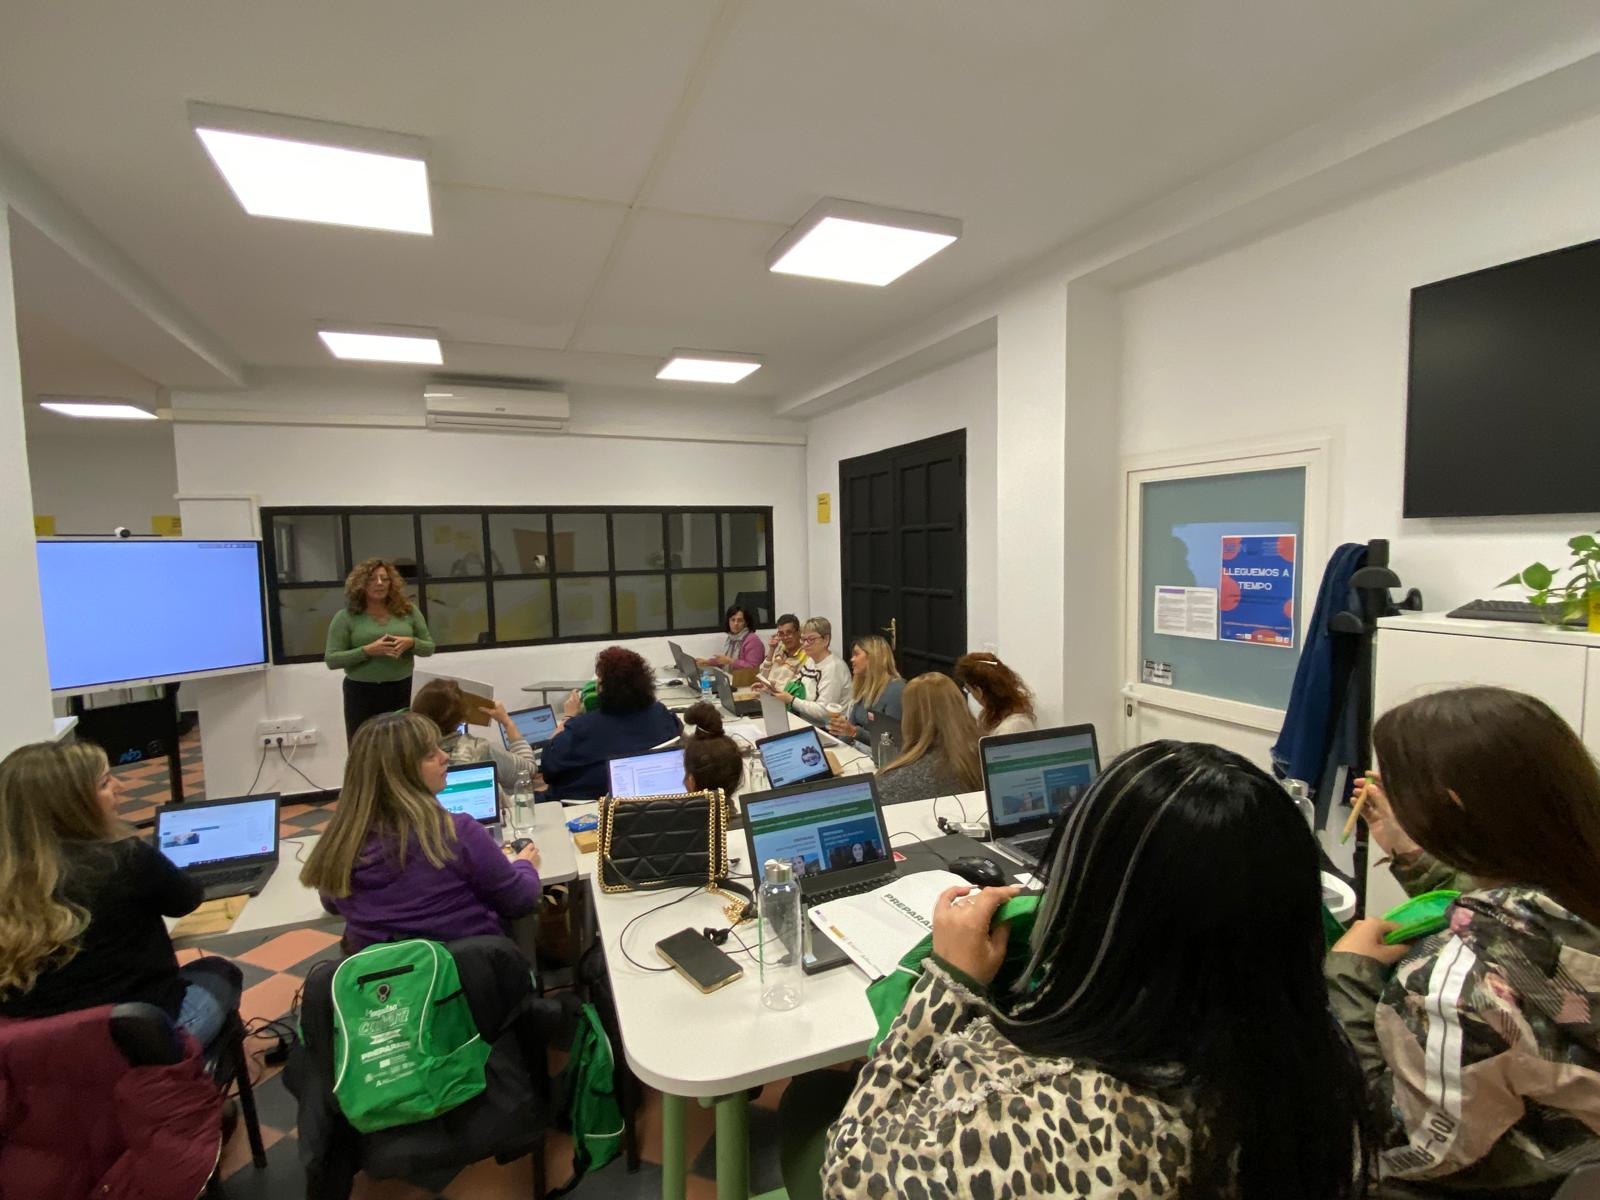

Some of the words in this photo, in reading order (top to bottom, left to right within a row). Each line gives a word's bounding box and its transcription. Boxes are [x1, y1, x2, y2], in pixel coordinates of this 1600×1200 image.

[1223, 567, 1280, 577] LLEGUEMOS
[1283, 568, 1290, 577] A
[1238, 581, 1273, 591] TIEMPO
